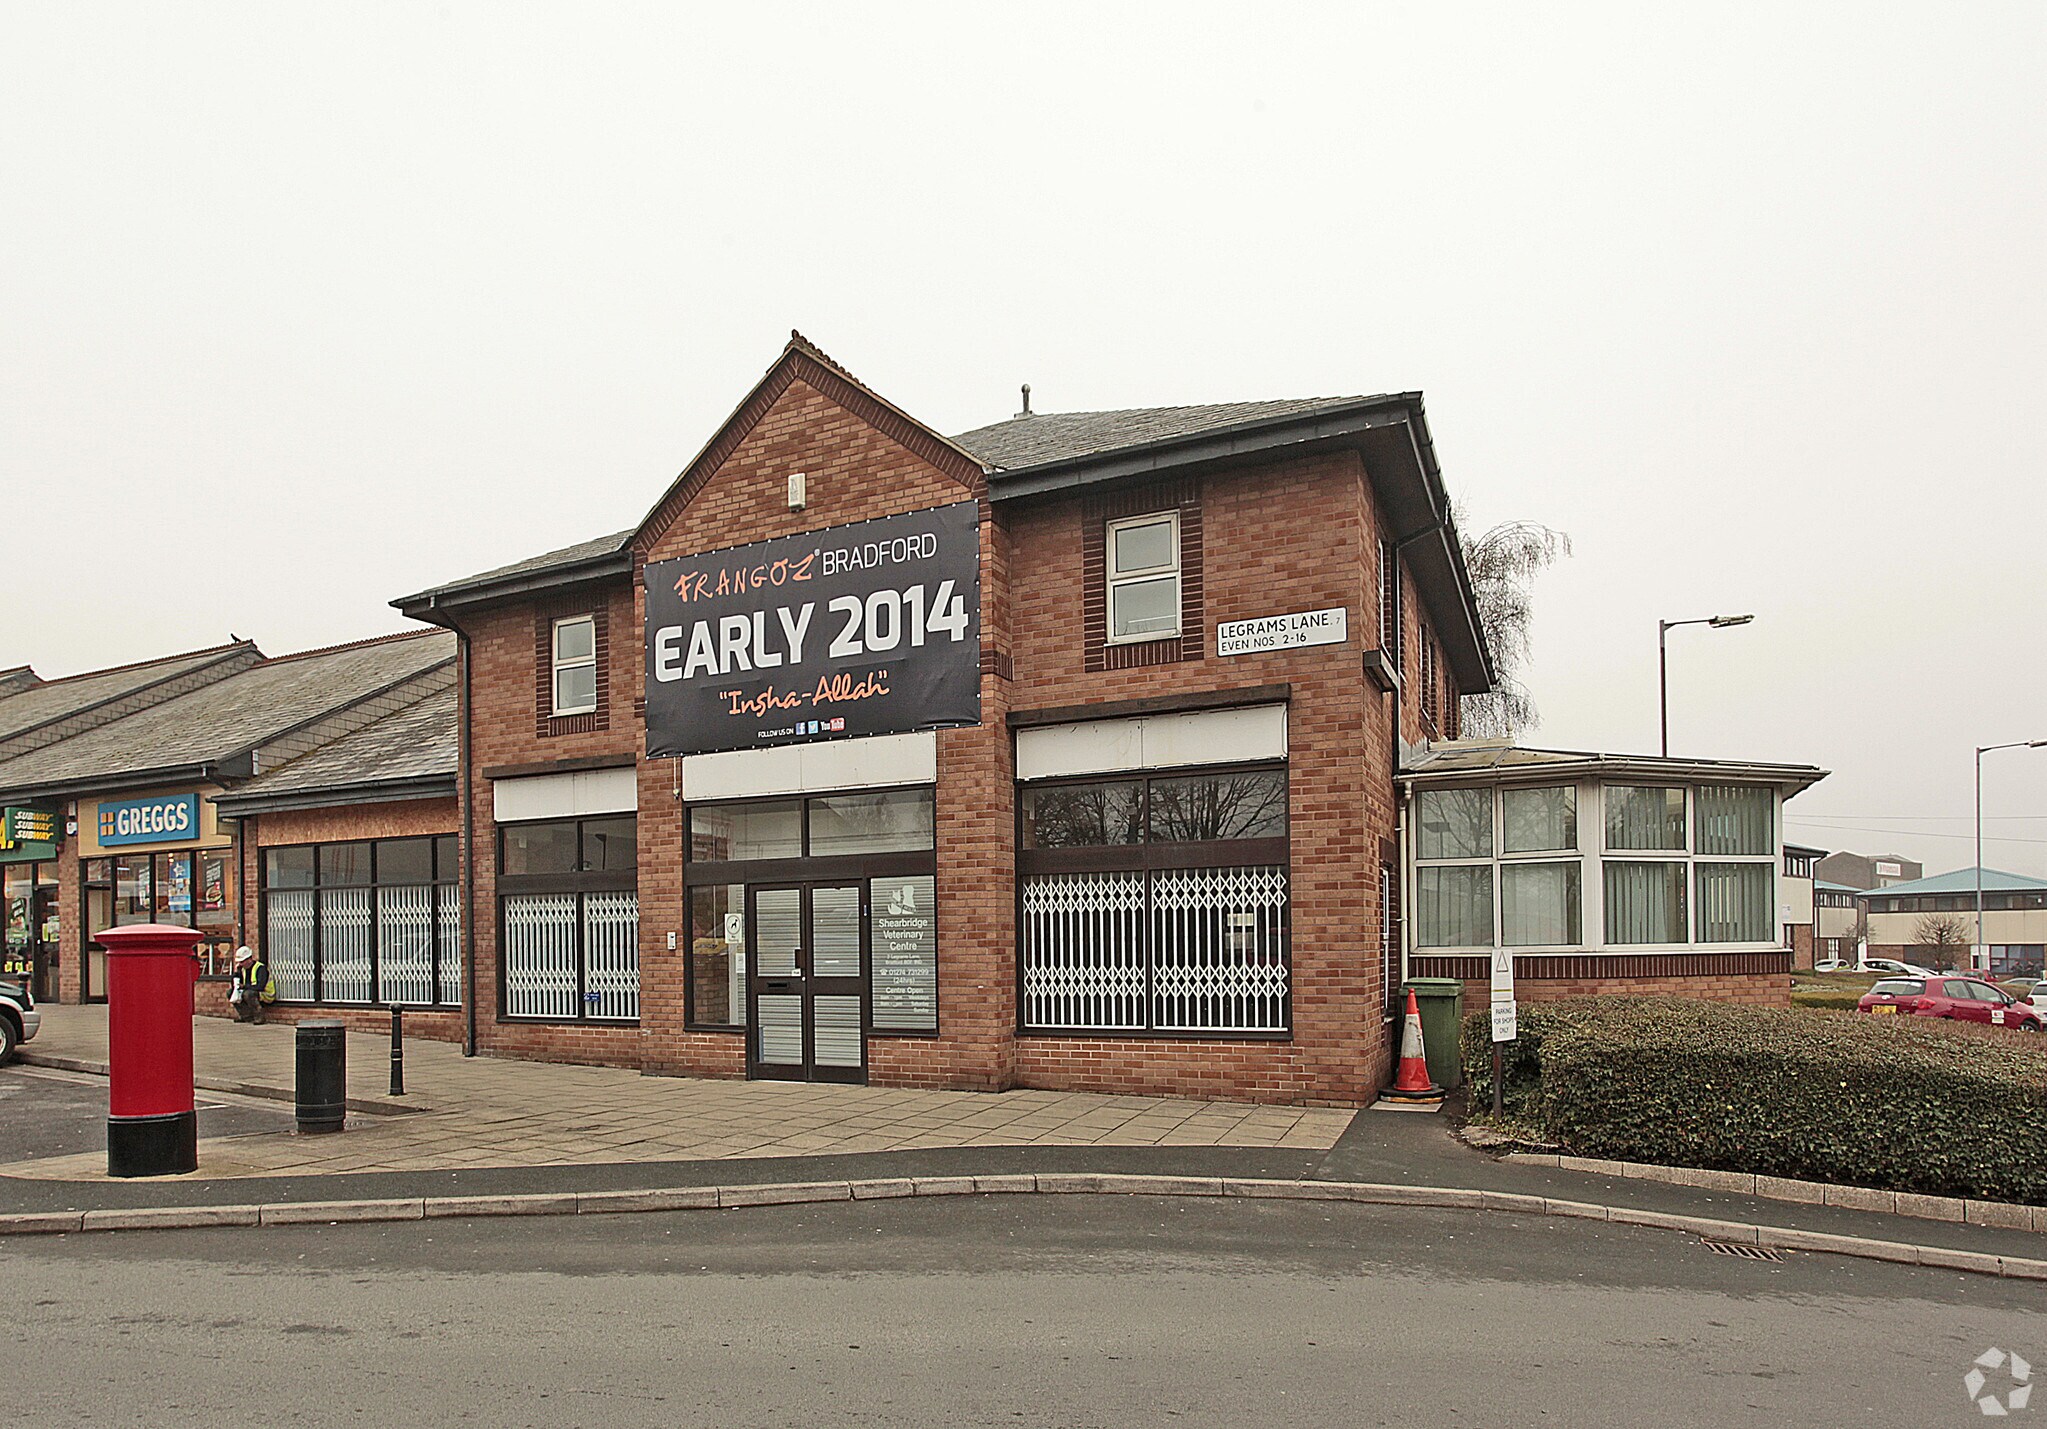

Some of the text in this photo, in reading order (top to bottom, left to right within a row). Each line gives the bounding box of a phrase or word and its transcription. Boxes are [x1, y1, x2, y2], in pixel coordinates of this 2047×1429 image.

[823, 533, 937, 575] BRADFORD
[655, 579, 969, 682] EARLY 2014
[1221, 618, 1287, 639] LEGRAMS
[1221, 640, 1249, 652] EVEN
[1282, 633, 1307, 644] 2-16
[719, 670, 890, 717] "Insha-Allah"
[758, 729, 778, 738] FOLLOW
[778, 728, 786, 736] US
[786, 727, 794, 735] ON
[14, 811, 54, 821] SUBWAY
[117, 802, 189, 836] GREGGS
[14, 820, 54, 831] SUBWAY
[14, 830, 54, 840] SUBWAY
[878, 918, 928, 929] Shearbridge
[883, 929, 924, 940] Veterinary
[890, 941, 917, 951] Centre
[885, 986, 924, 995] Centre Open
